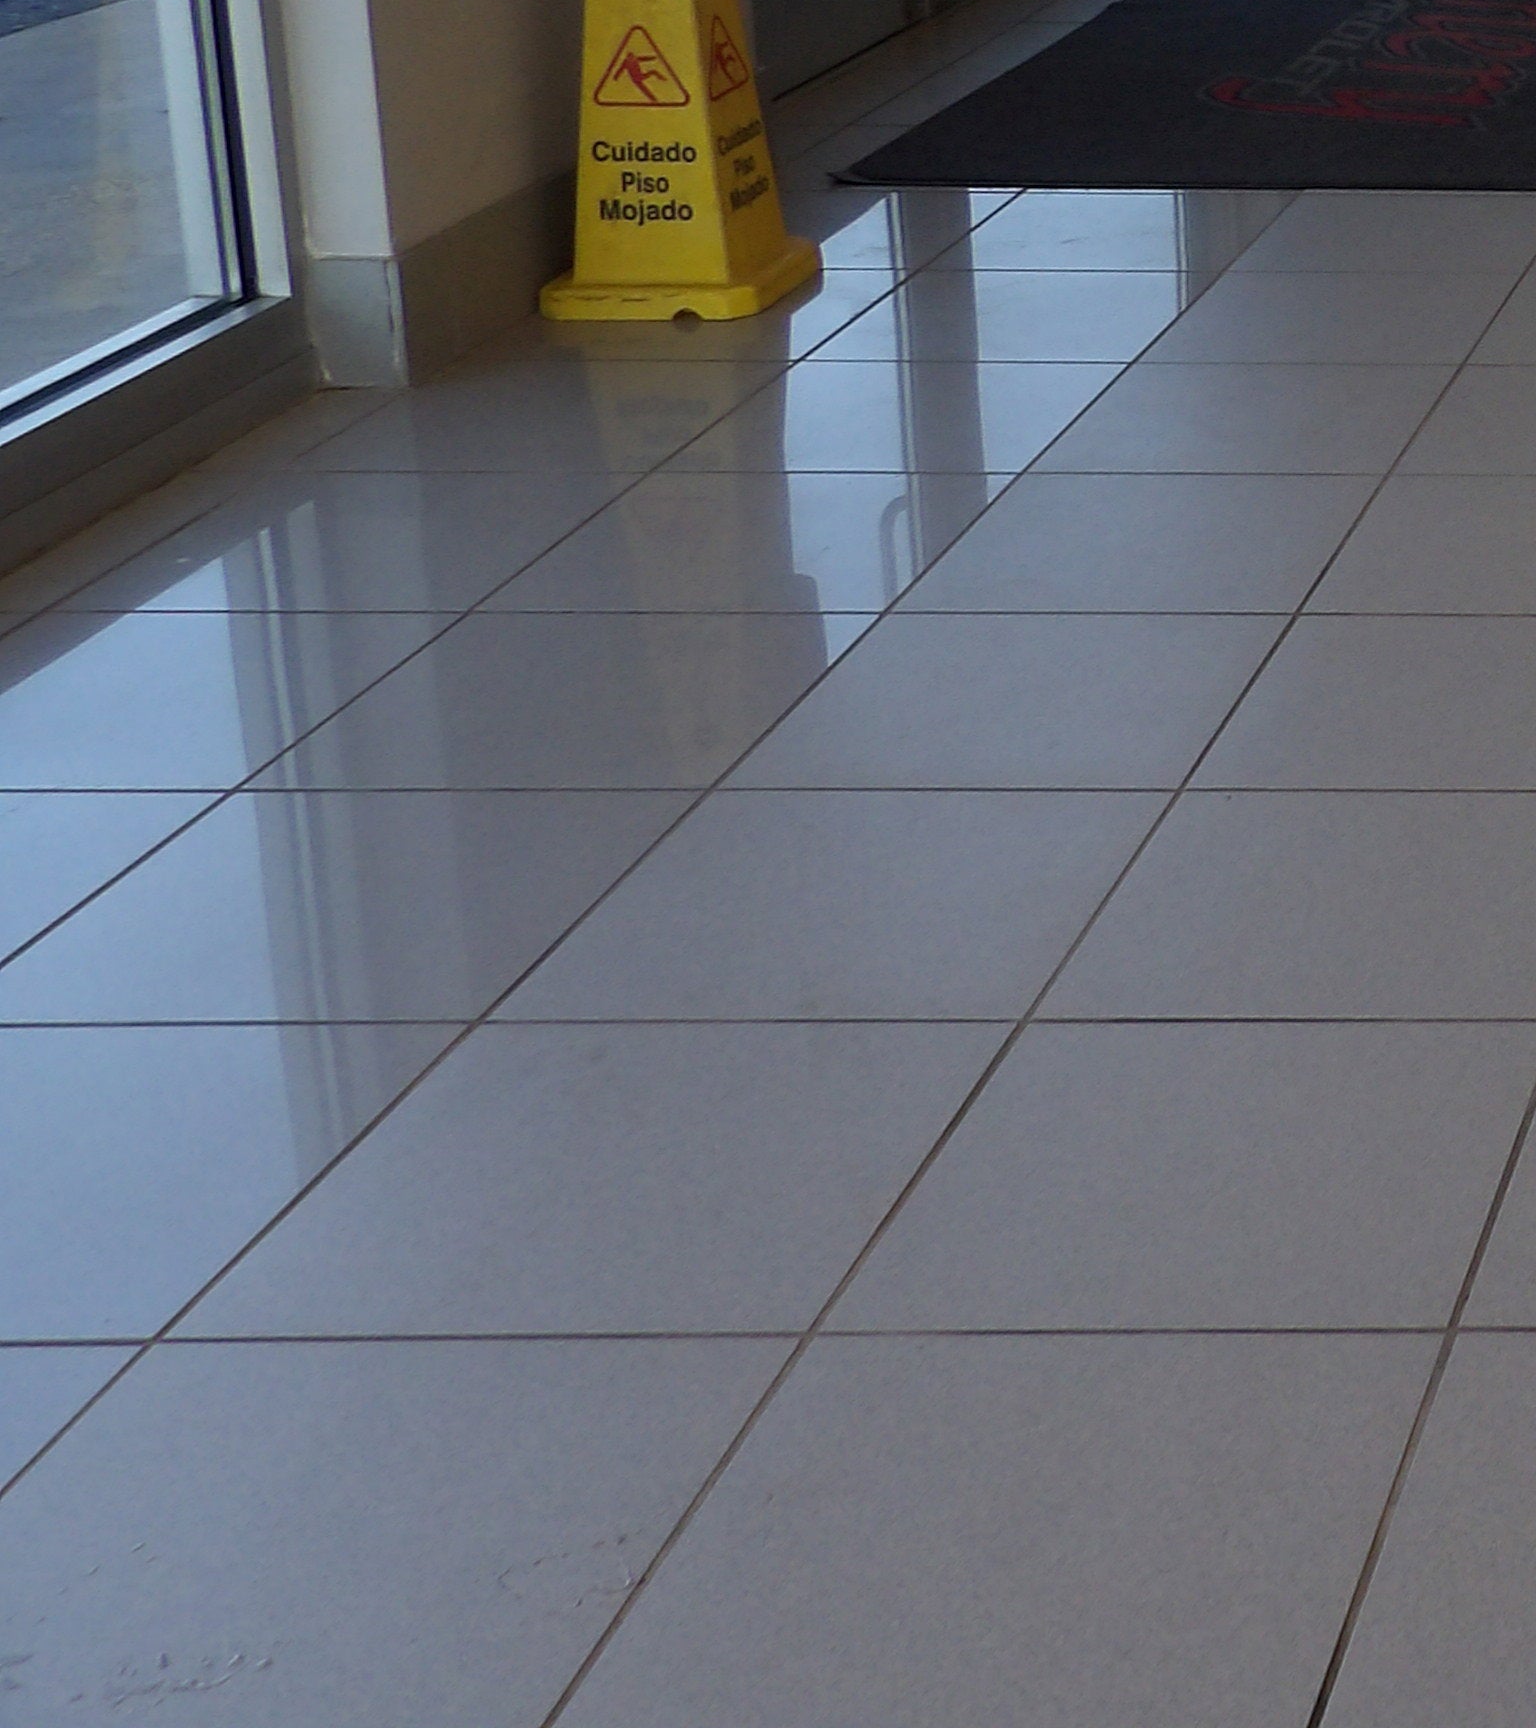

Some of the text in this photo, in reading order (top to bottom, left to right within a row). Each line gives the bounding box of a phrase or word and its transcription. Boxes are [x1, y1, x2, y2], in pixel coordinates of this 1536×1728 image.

[592, 140, 698, 164] Cuidado
[621, 171, 670, 194] Piso
[599, 197, 694, 227] Mojado
